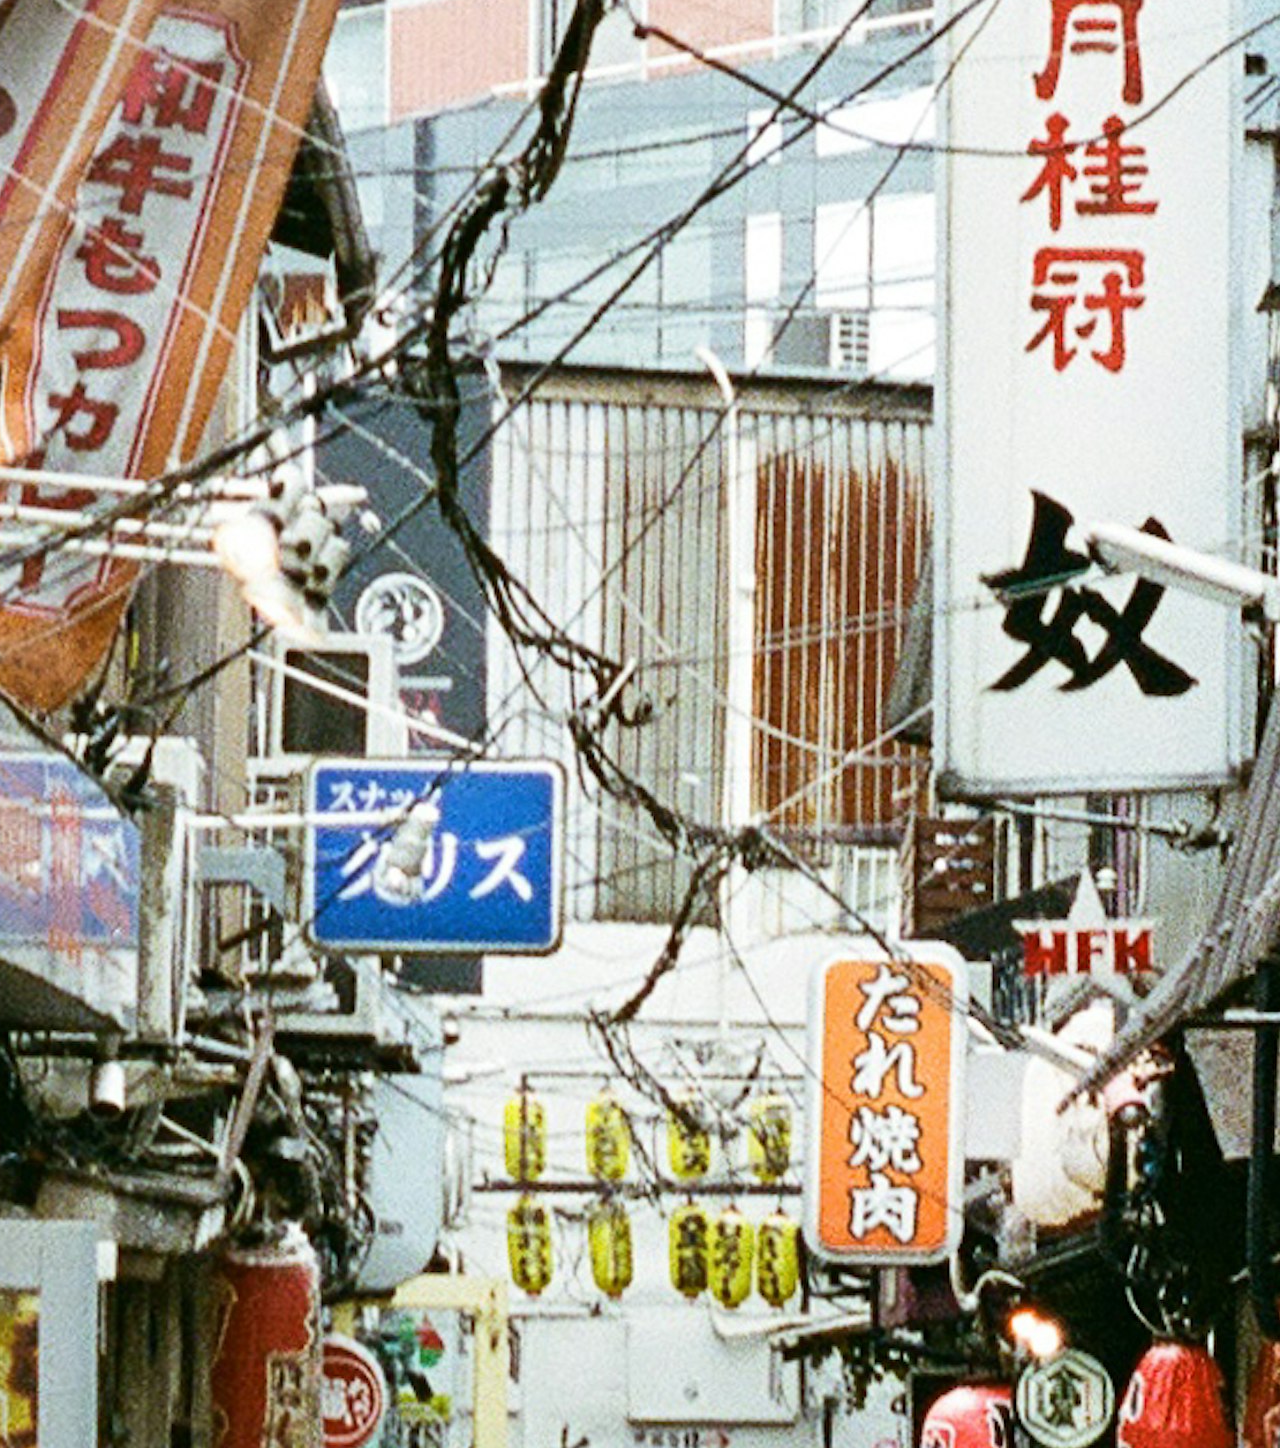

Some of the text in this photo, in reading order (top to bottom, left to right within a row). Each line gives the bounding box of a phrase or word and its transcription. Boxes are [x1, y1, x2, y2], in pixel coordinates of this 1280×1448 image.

[980, 490, 1199, 697] 奴
[847, 963, 925, 1246] たれ焼肉
